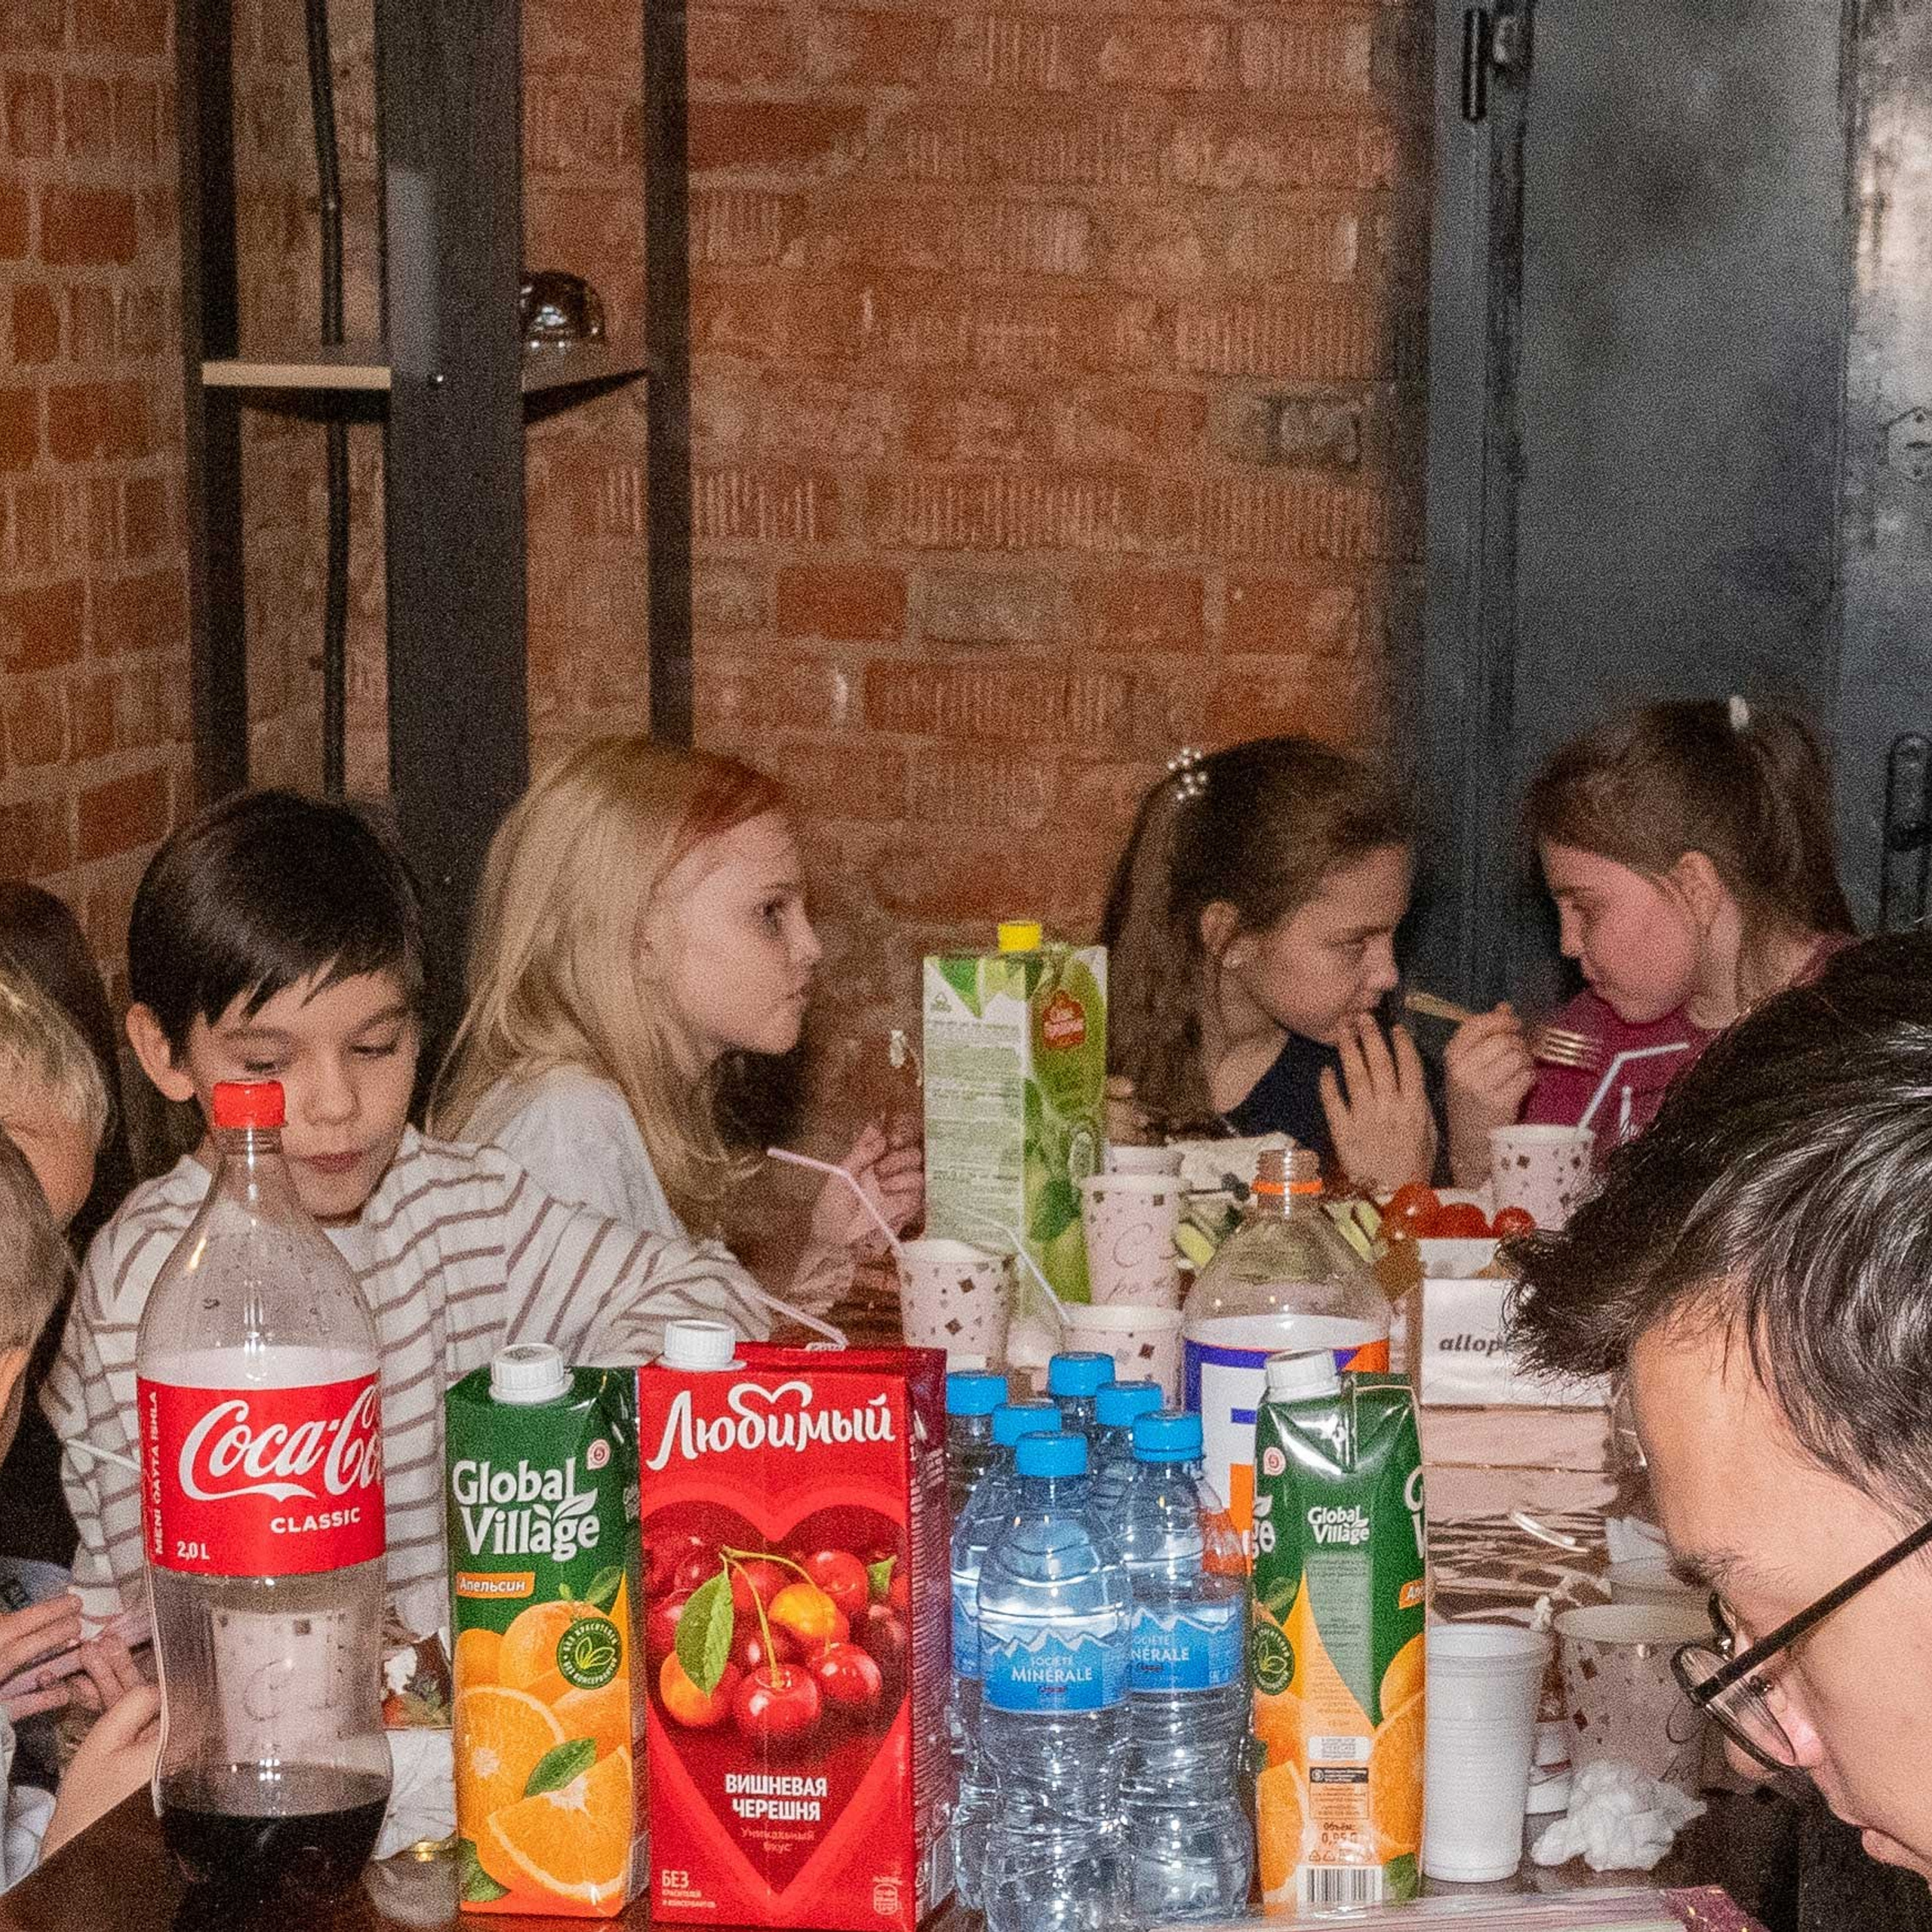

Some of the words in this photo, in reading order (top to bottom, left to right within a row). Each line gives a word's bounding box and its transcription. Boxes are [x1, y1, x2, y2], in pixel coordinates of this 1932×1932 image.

[1438, 1334, 1508, 1356] allop
[646, 1380, 897, 1471] Любимый
[453, 1457, 577, 1506] Global
[270, 1507, 361, 1534] CLASSIC
[1307, 1504, 1363, 1524] Global
[461, 1506, 601, 1562] Village
[1312, 1524, 1371, 1546] Village
[460, 1577, 526, 1592] Апельсин
[1131, 1647, 1190, 1661] NÉRALE
[725, 1774, 828, 1798] ВИШНЕВАЯ
[732, 1799, 821, 1822] ЧЕРЕШНЯ
[661, 1869, 690, 1888] БЕЗ
